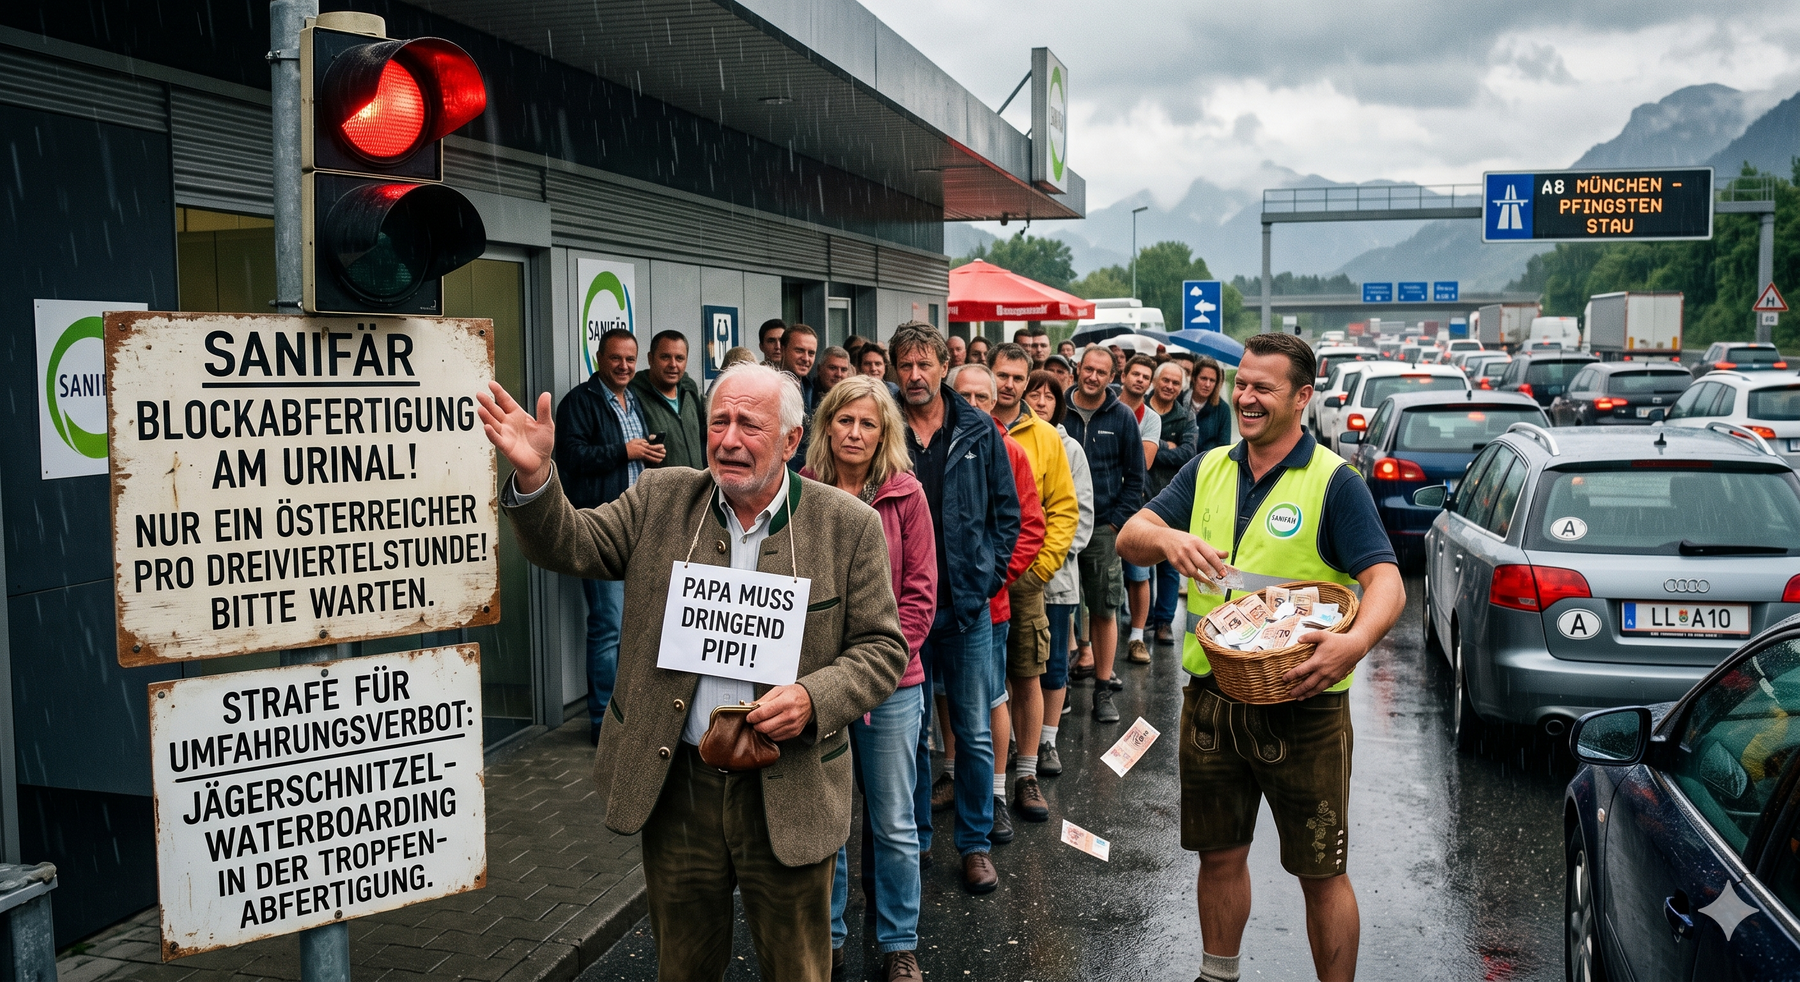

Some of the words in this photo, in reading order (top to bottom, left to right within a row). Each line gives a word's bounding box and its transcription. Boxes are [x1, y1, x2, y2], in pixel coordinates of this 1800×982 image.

[1541, 179, 1565, 195] A8
[1576, 176, 1663, 194] MÜNCHEN
[1559, 198, 1663, 215] PFINGSTEN
[1586, 218, 1634, 234] STAU
[204, 323, 415, 377] SANIFÄR
[137, 396, 475, 441] BLOCKABFERTIGUNG
[212, 448, 267, 490] AM
[283, 443, 418, 485] URINAL!
[135, 511, 201, 548] NUR
[215, 507, 263, 543] EIN
[276, 494, 477, 538] ÖSTERREICHER
[1561, 520, 1576, 536] A
[134, 556, 194, 593] PRO
[207, 533, 487, 587] DREIVIERTELSTUNDE!
[212, 589, 296, 631] BITTE
[309, 577, 435, 619] WARTEN.
[682, 576, 731, 603] PAPA
[738, 584, 795, 611] MUSS
[681, 606, 785, 640] DRINGEND
[1570, 612, 1588, 636] A
[1651, 607, 1676, 627] LL
[1691, 608, 1731, 629] A10
[701, 638, 758, 668] PIPI!
[222, 678, 340, 725] STRAFE
[354, 665, 411, 706] FÜR
[169, 699, 474, 773] UMFAHRUNGSVERBOT:
[182, 752, 457, 825] JÄGERSCHNITZEL-
[204, 787, 457, 862] WATERBOARDING
[217, 866, 246, 897] IN
[256, 855, 308, 890] DER
[318, 828, 448, 876] TROPFEN-
[240, 864, 433, 929] ABFERTIGUNG.
